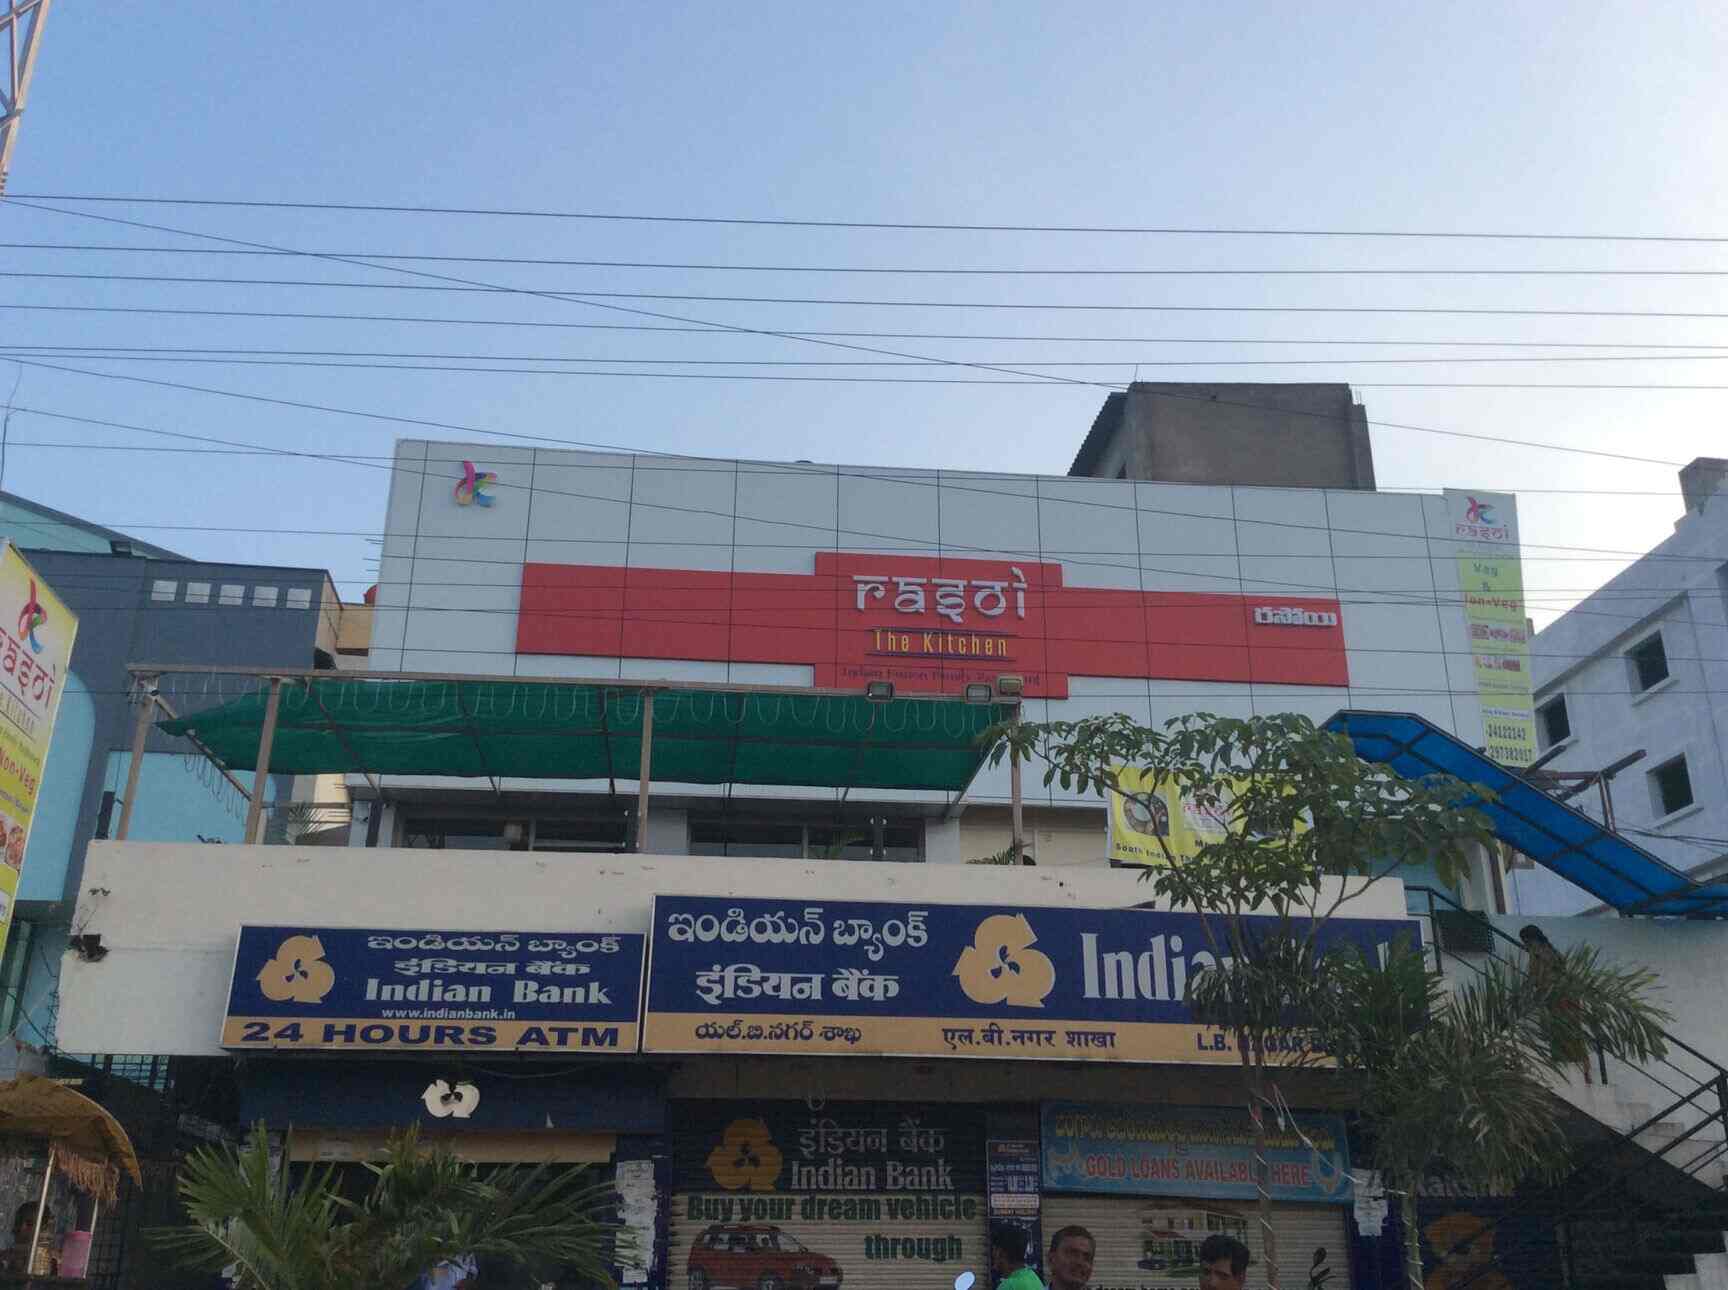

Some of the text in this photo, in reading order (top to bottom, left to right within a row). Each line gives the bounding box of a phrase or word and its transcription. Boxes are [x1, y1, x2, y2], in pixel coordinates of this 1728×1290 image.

[874, 628, 1008, 657] The Kitchen
[367, 933, 622, 959] ఇండియన్ బ్యాంక్
[667, 906, 929, 962] ఇండియన్ బ్యాంక్
[393, 956, 592, 976] इंडियन बैंक
[365, 977, 613, 1005] Indian Bank
[695, 963, 900, 1005] इंडियन बैंक
[381, 1006, 517, 1021] www.indianbank.in
[241, 1022, 620, 1048] 24 HOURS ATM
[1064, 1030, 1117, 1049] शाखा
[797, 1114, 953, 1159] इंडियन बैंक
[791, 1158, 878, 1191] Indian
[884, 1160, 955, 1191] Bank
[1086, 1153, 1126, 1179] GOLD
[1131, 1156, 1180, 1180] LOANS
[1271, 1164, 1310, 1186] HERE
[687, 1194, 977, 1222] Buy your dream vehicle
[863, 1232, 963, 1262] through
